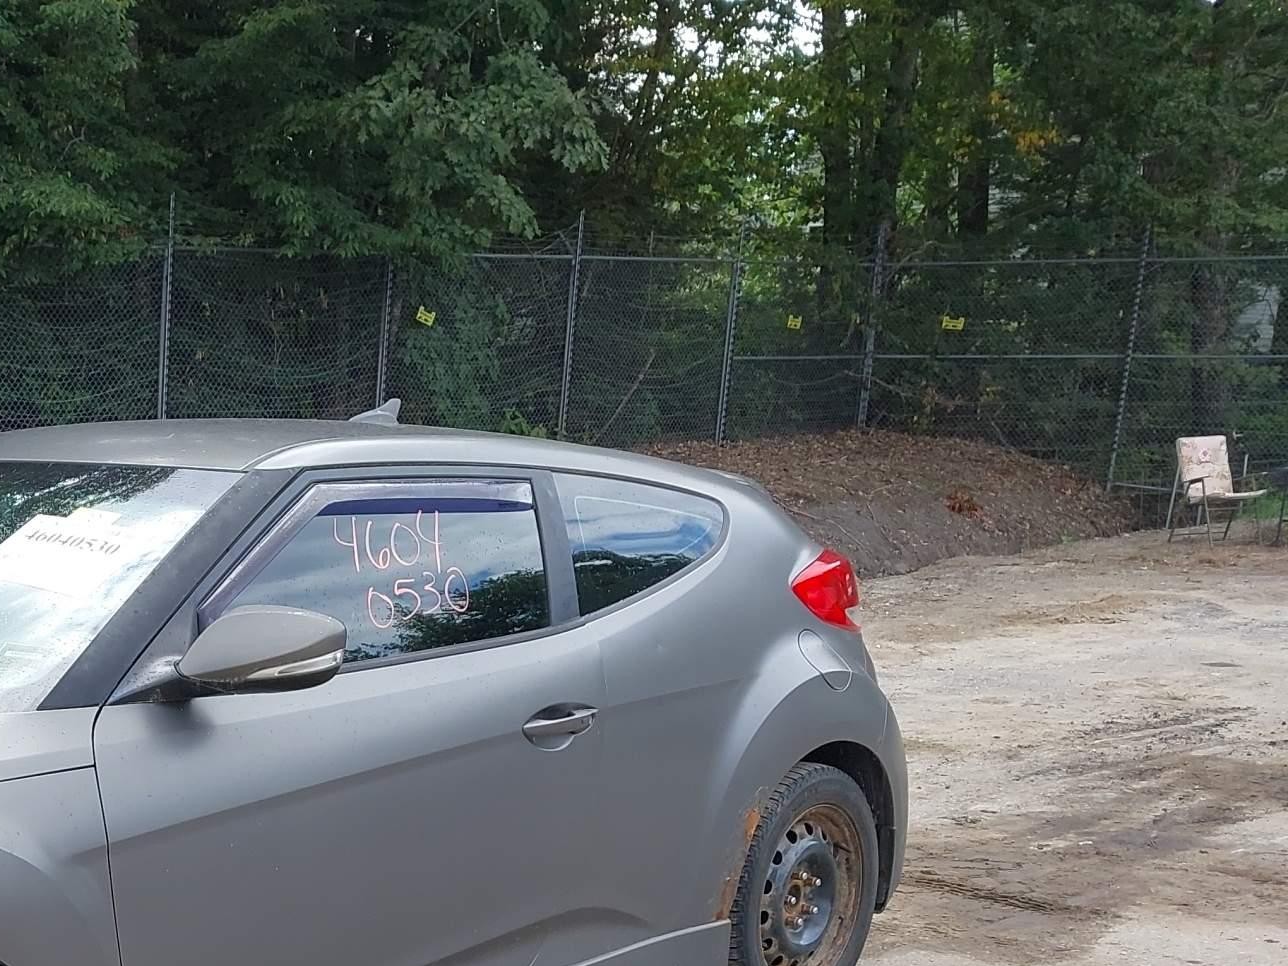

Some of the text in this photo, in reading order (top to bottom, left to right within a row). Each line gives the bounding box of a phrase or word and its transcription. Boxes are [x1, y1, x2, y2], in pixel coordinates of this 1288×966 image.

[25, 529, 121, 555] 46040530
[332, 509, 443, 574] 4604
[367, 566, 469, 629] 0530
